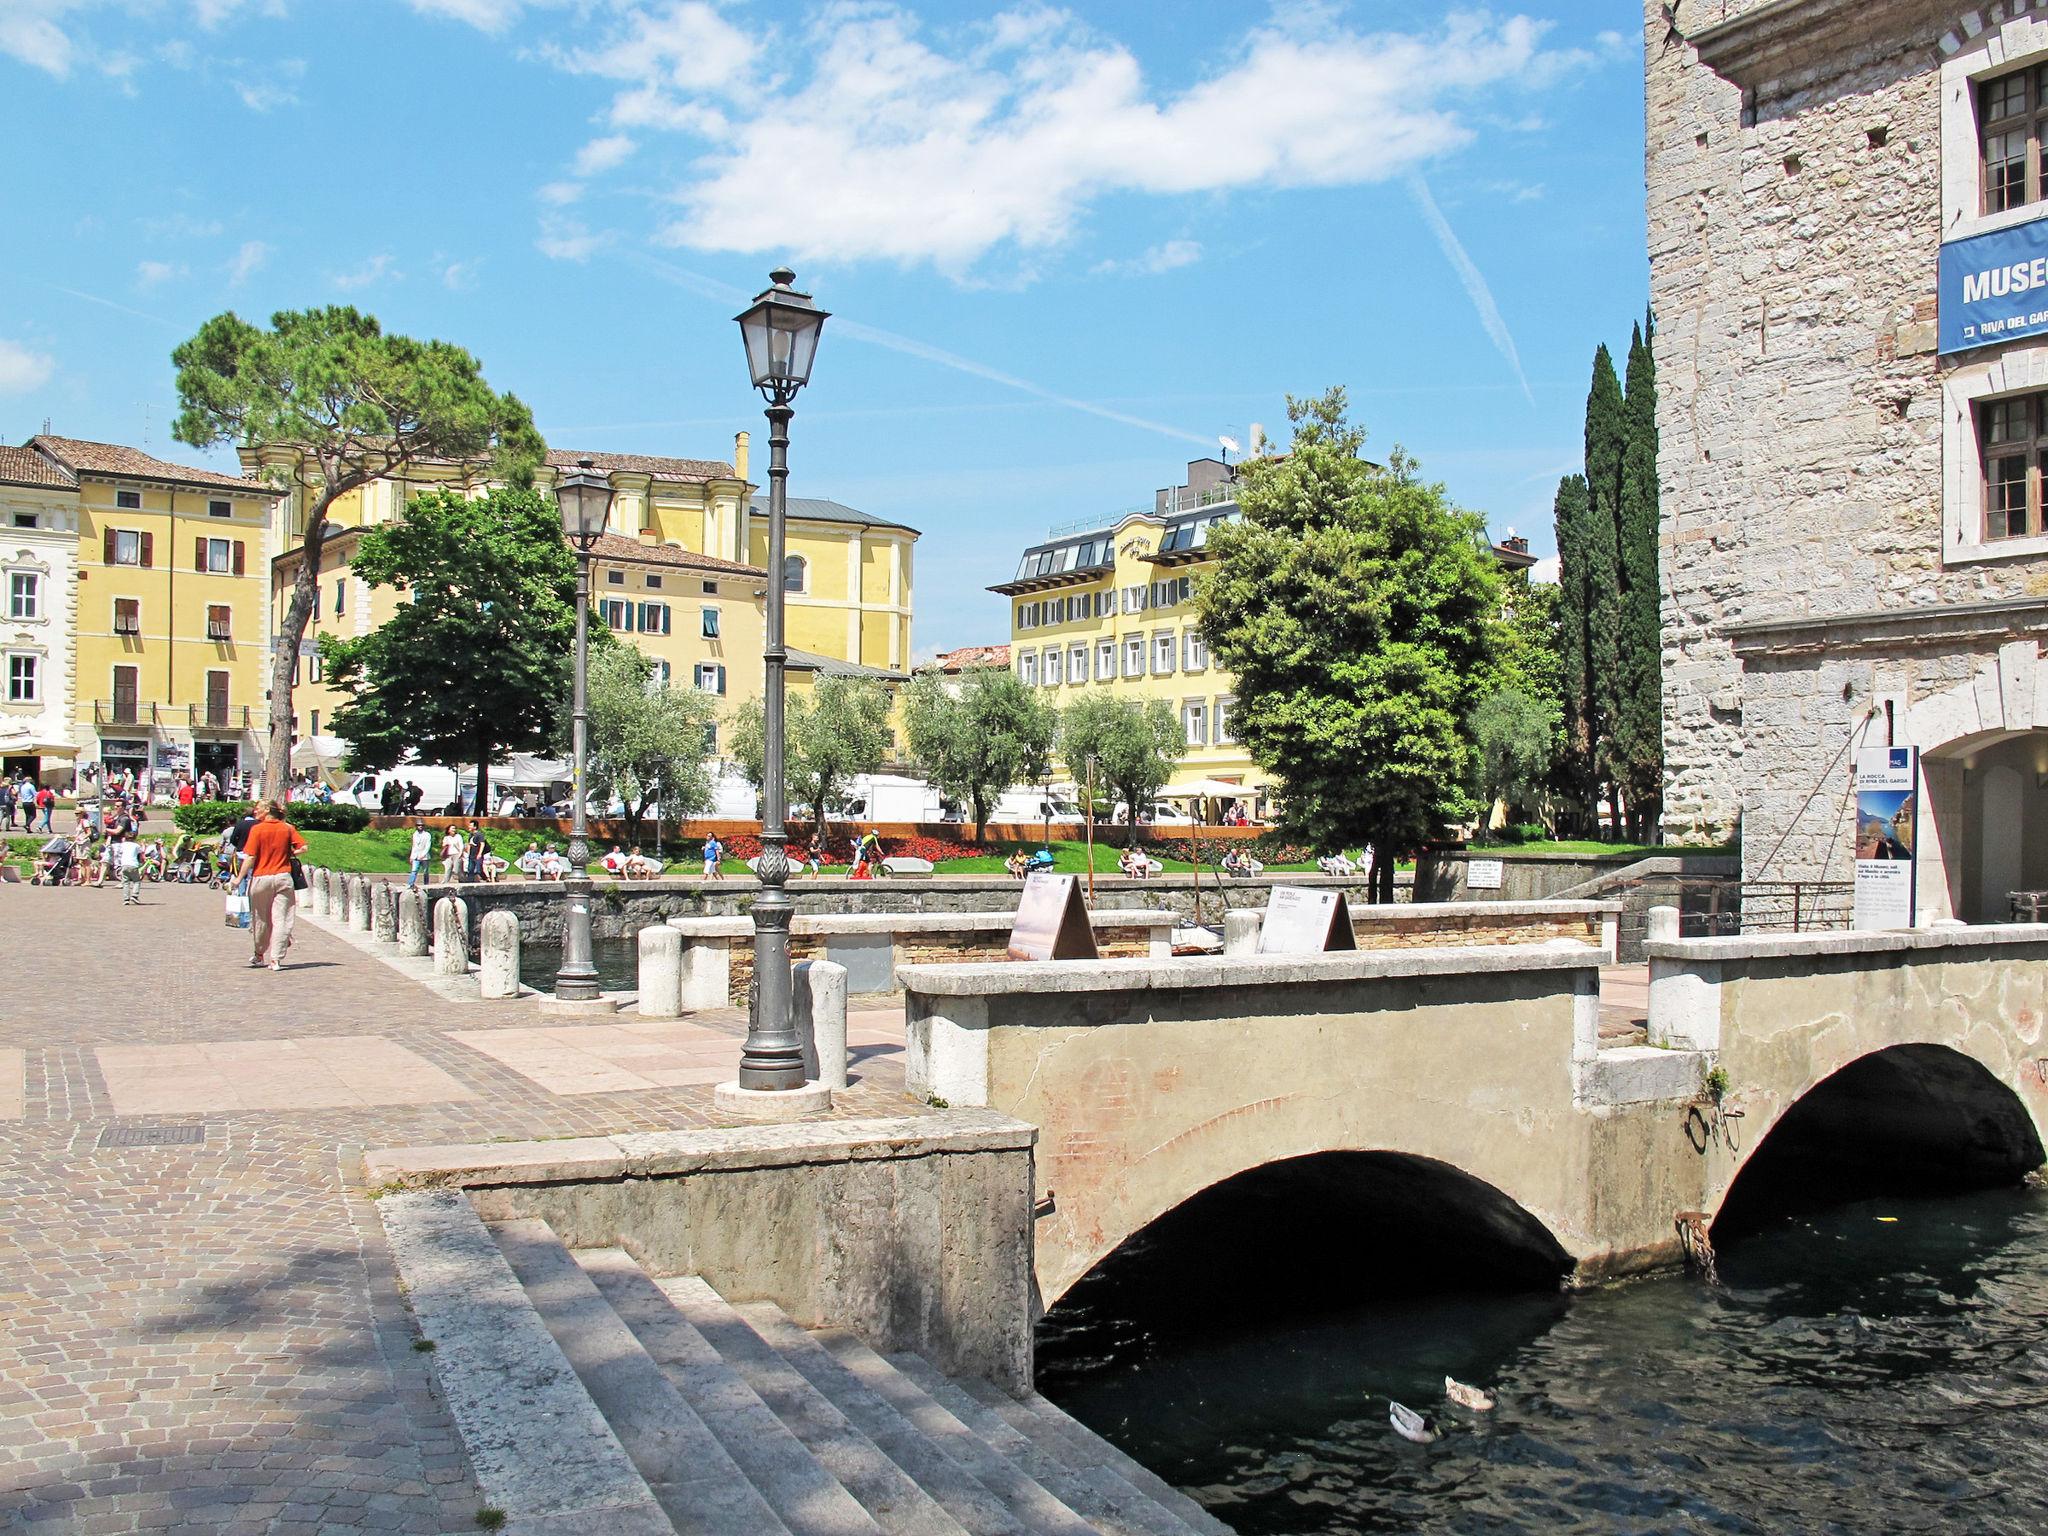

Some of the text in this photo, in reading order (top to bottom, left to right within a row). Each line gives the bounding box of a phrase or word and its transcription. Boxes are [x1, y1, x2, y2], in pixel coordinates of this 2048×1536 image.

[1963, 258, 2048, 304] MUSE
[1981, 319, 2005, 335] RIVA
[2007, 315, 2028, 330] DEL
